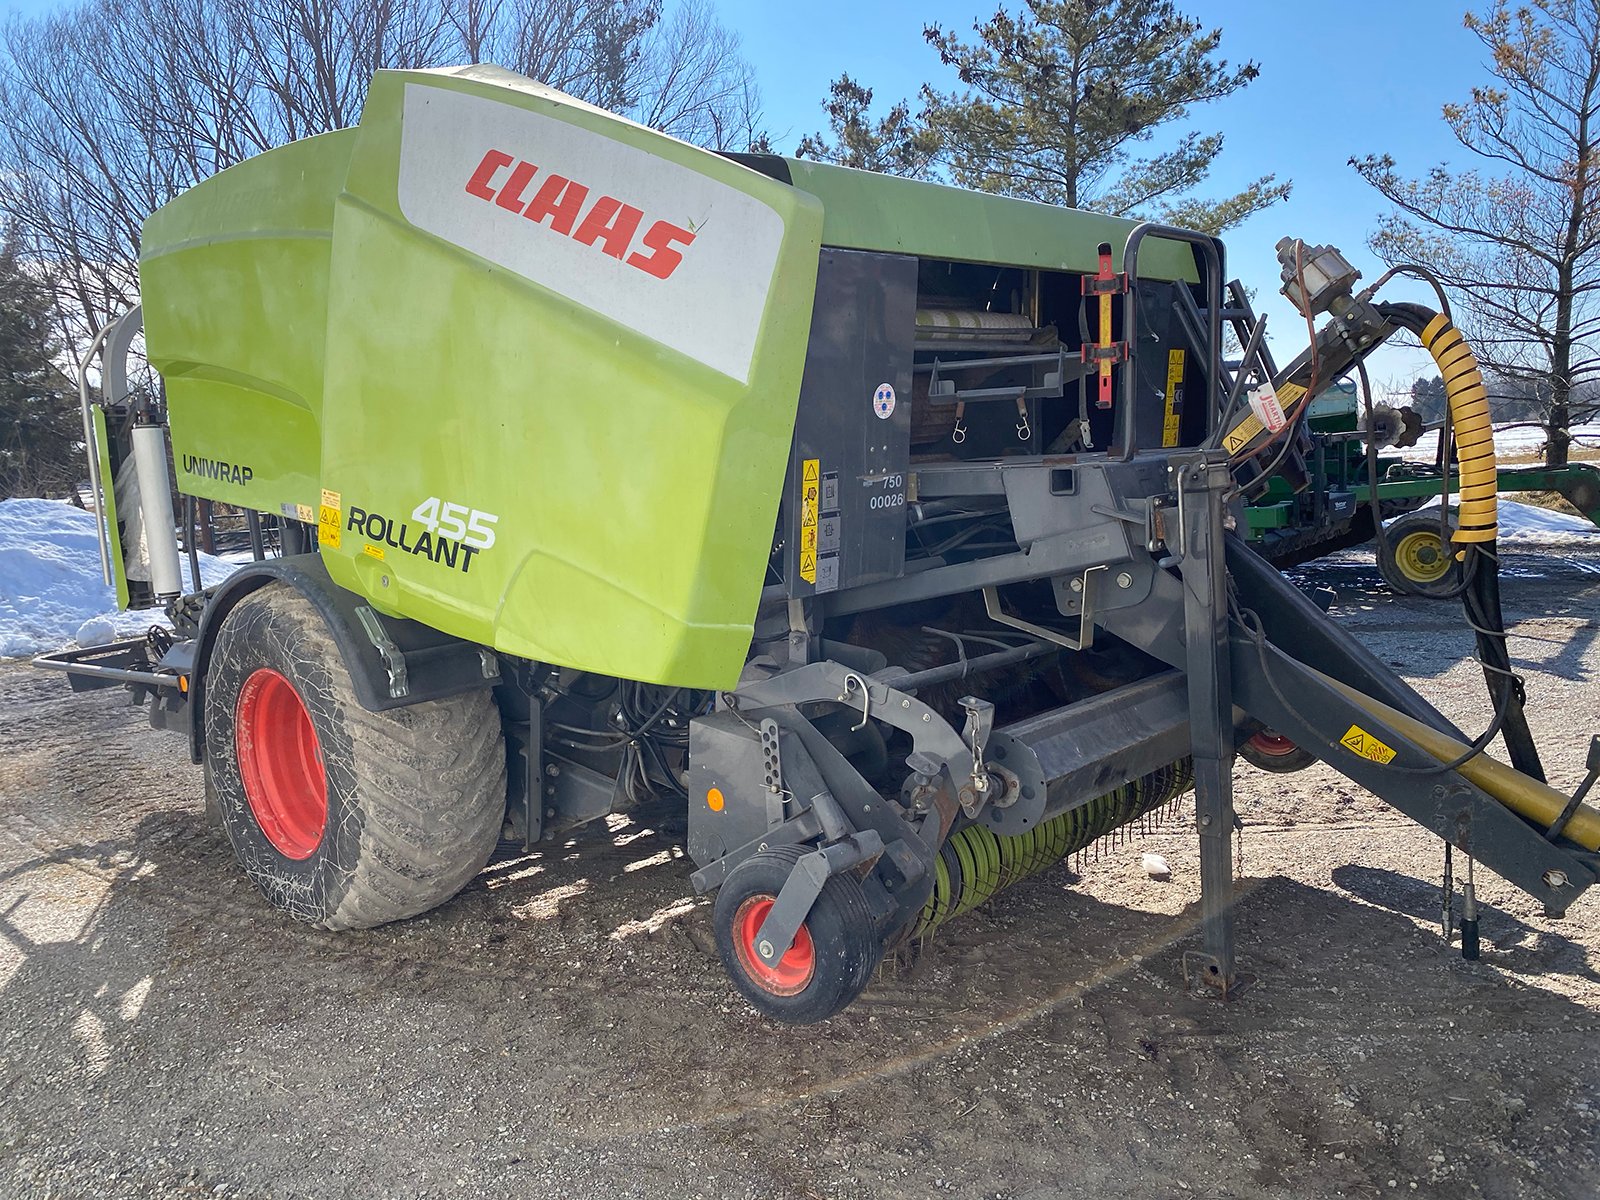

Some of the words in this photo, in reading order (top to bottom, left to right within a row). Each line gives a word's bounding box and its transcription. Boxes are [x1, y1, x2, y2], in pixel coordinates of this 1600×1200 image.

[465, 149, 697, 280] CLAAS
[183, 454, 253, 486] UNIWRAP
[883, 475, 902, 489] 750
[411, 496, 499, 550] 455
[870, 493, 904, 510] 00026
[347, 505, 480, 573] ROLLANT
